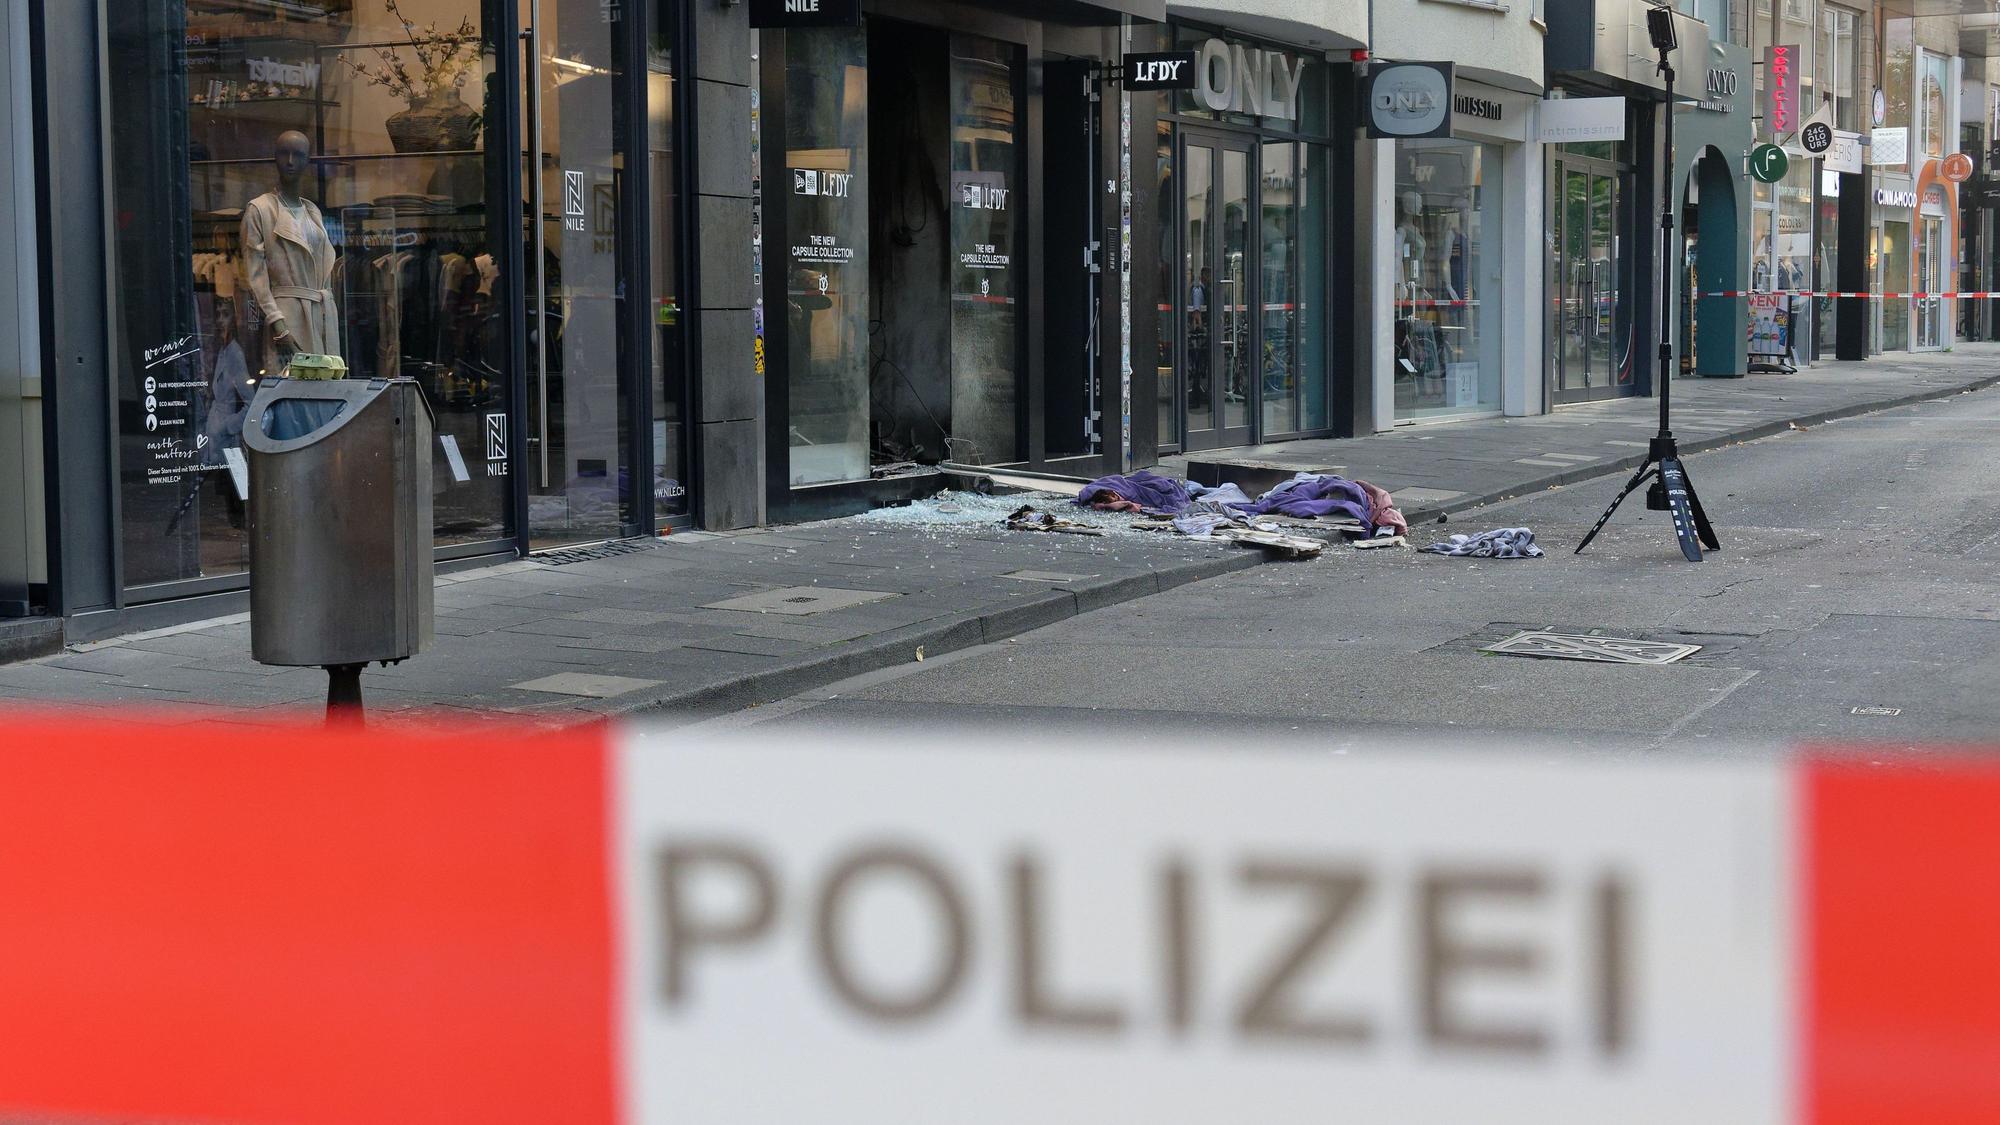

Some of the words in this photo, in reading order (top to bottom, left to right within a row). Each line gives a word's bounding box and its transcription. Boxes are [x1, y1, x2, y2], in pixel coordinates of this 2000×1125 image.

[785, 0, 819, 12] NILE
[1192, 38, 1304, 120] ONLY
[1107, 180, 1116, 193] 34
[1877, 188, 1917, 208] CINNAMOOD
[565, 217, 585, 231] NILE
[811, 235, 822, 245] THE
[823, 236, 836, 246] NEW
[792, 246, 818, 257] CAPSULE
[819, 248, 854, 258] COLLECTION
[975, 244, 984, 253] THE
[985, 245, 996, 254] NEW
[960, 253, 981, 264] CAPSULE
[982, 255, 1010, 264] COLLECTION
[188, 463, 200, 472] 100%
[487, 462, 508, 477] NILE
[649, 836, 1642, 1066] POLIZEI
